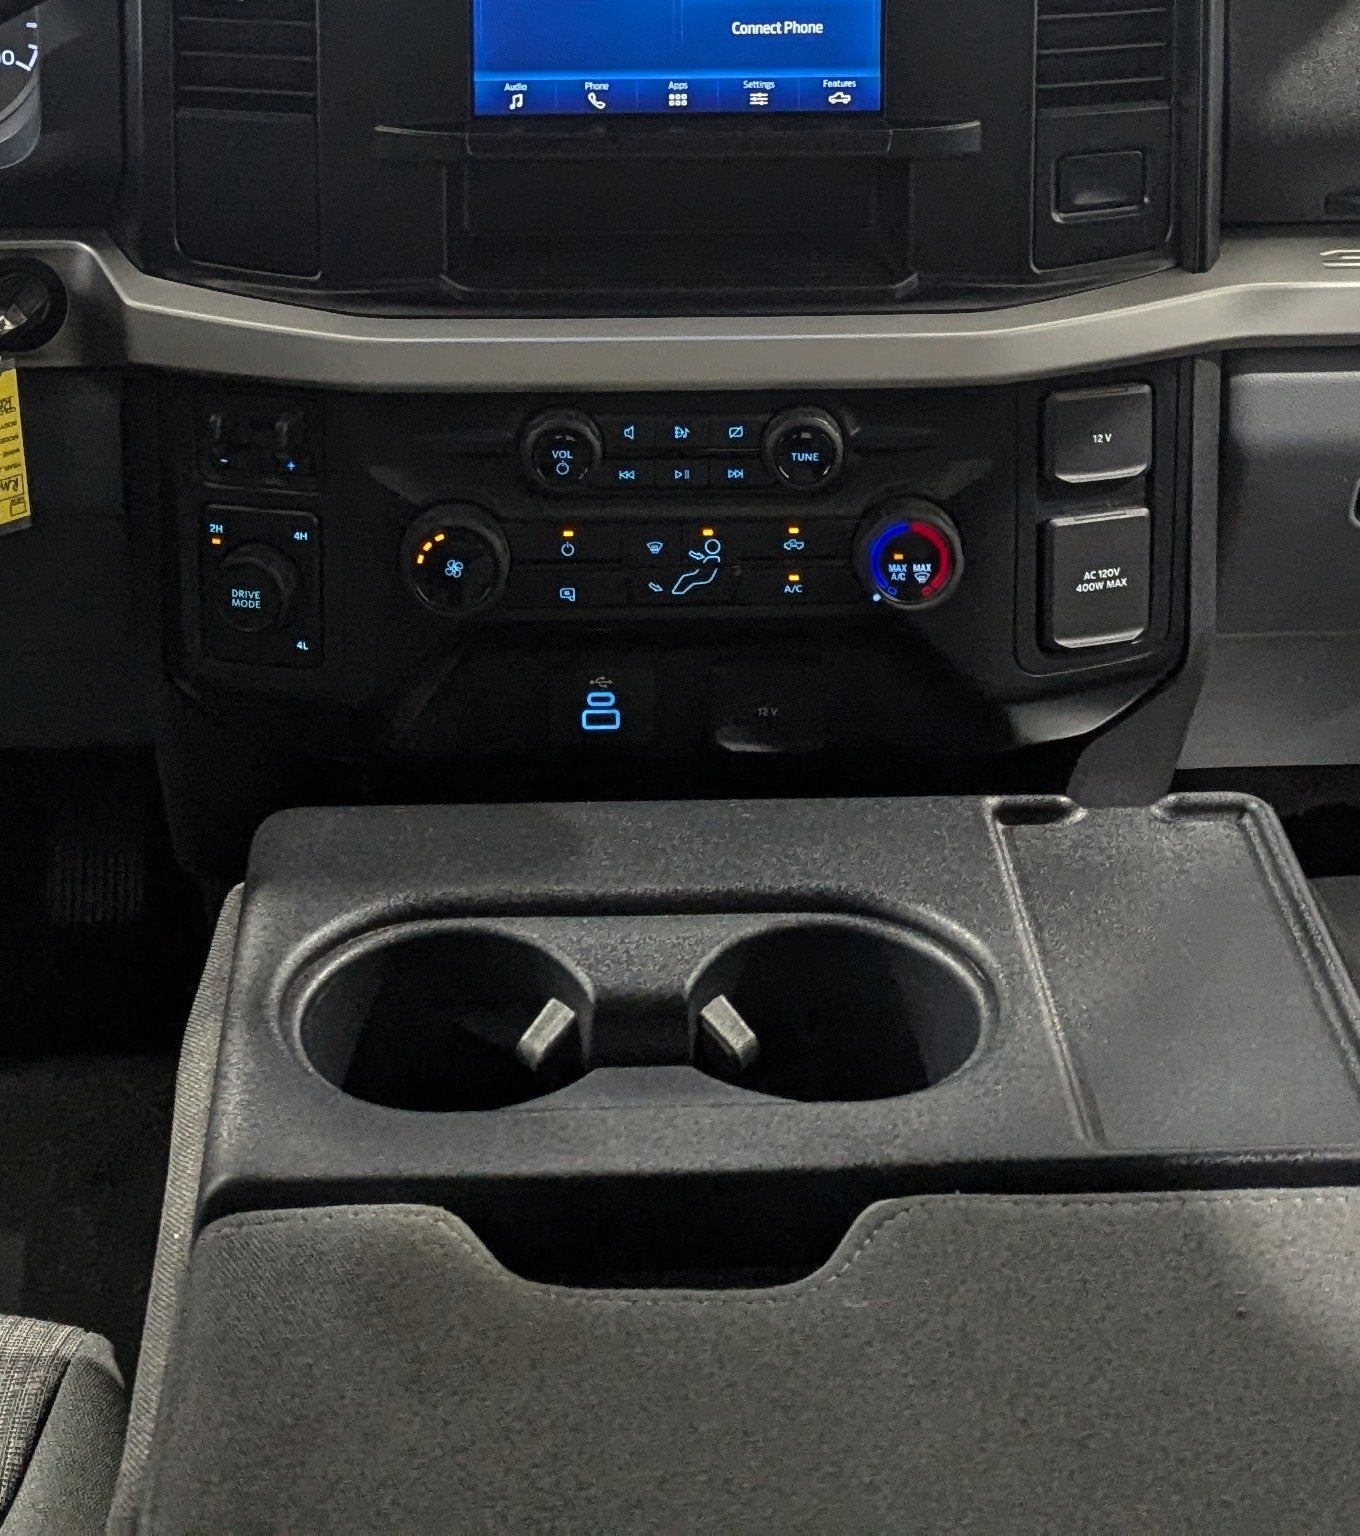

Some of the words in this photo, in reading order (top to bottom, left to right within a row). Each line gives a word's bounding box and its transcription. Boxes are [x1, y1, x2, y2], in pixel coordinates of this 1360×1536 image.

[731, 20, 782, 35] Connect
[784, 20, 824, 34] Phone
[503, 81, 528, 91] Audio
[584, 80, 610, 91] Phone
[667, 80, 688, 92] Apps
[742, 79, 776, 91] Settings
[822, 78, 857, 89] Features
[1092, 434, 1104, 443] 12
[1104, 433, 1113, 443] V
[551, 450, 573, 459] VOL
[790, 452, 820, 462] TUNE
[209, 523, 224, 534] 2H
[293, 531, 308, 541] 4H
[888, 563, 907, 573] MAX
[912, 563, 932, 573] MAX
[890, 572, 907, 582] A/C
[1083, 570, 1097, 581] AC
[1098, 567, 1121, 579] 120V
[783, 584, 803, 594] A/C
[1075, 580, 1104, 593] 400W
[1106, 577, 1128, 588] MAX
[231, 589, 261, 600] DRIVE
[231, 598, 262, 609] MODE
[296, 641, 309, 651] 4L
